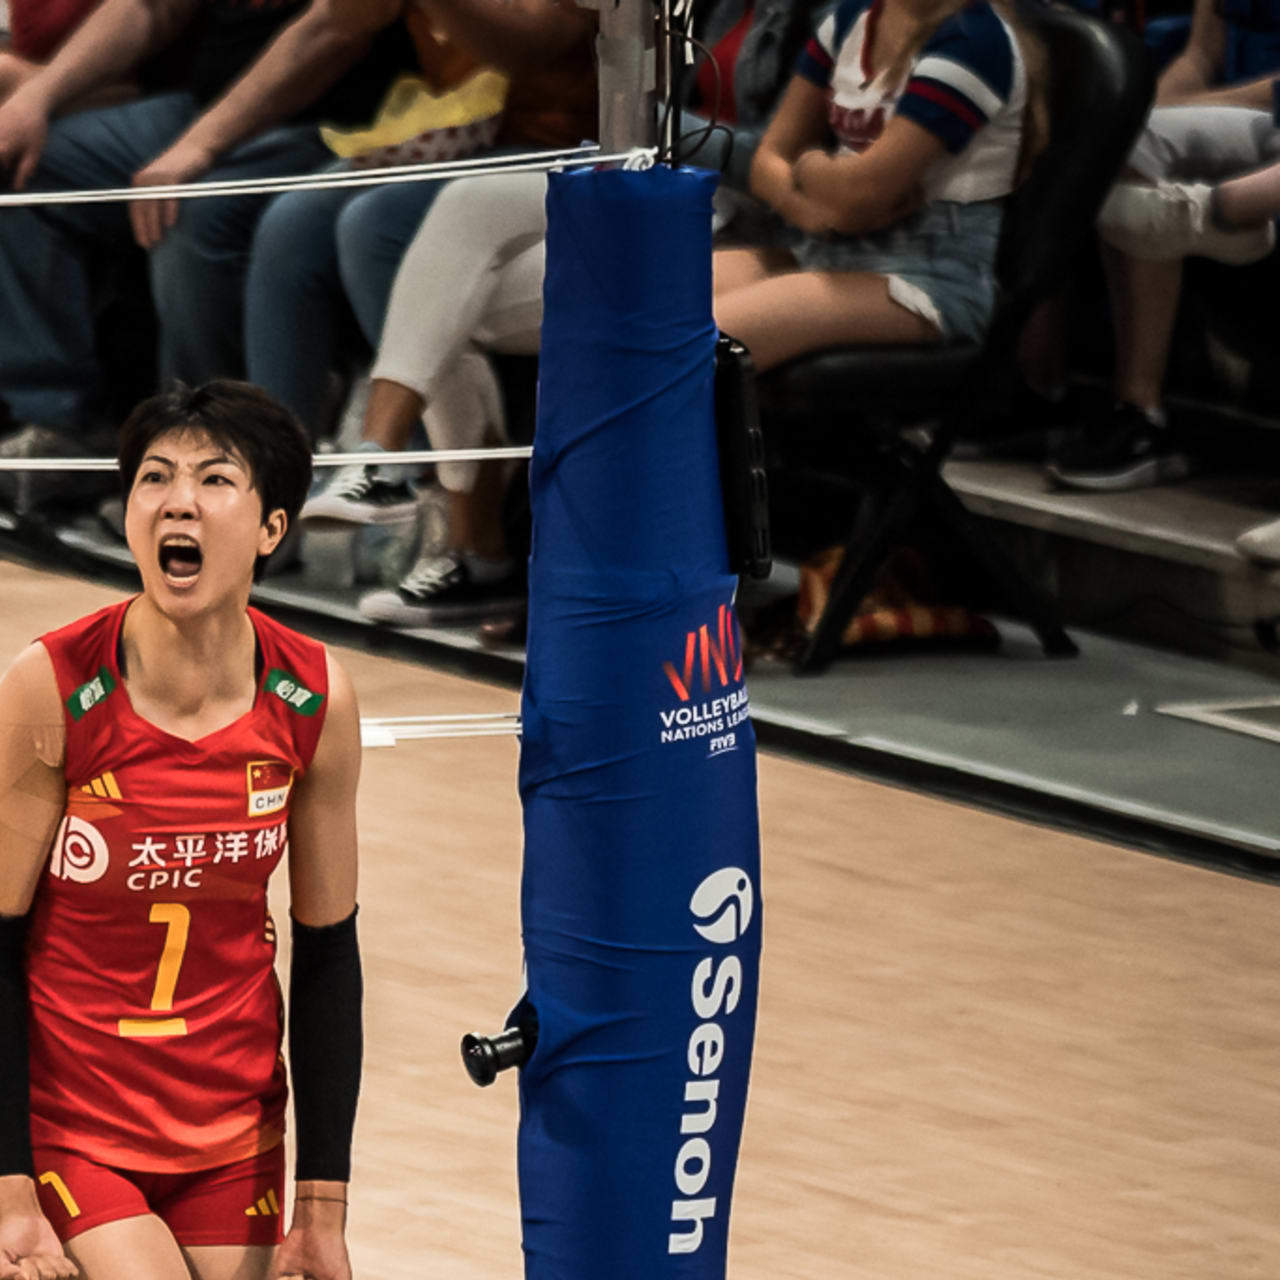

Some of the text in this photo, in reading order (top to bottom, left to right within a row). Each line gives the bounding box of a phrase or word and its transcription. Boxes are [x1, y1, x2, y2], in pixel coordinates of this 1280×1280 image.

[661, 719, 724, 743] NATIONS
[127, 868, 203, 891] CPIC
[668, 955, 743, 1255] Senoh
[39, 1170, 81, 1219] 1
